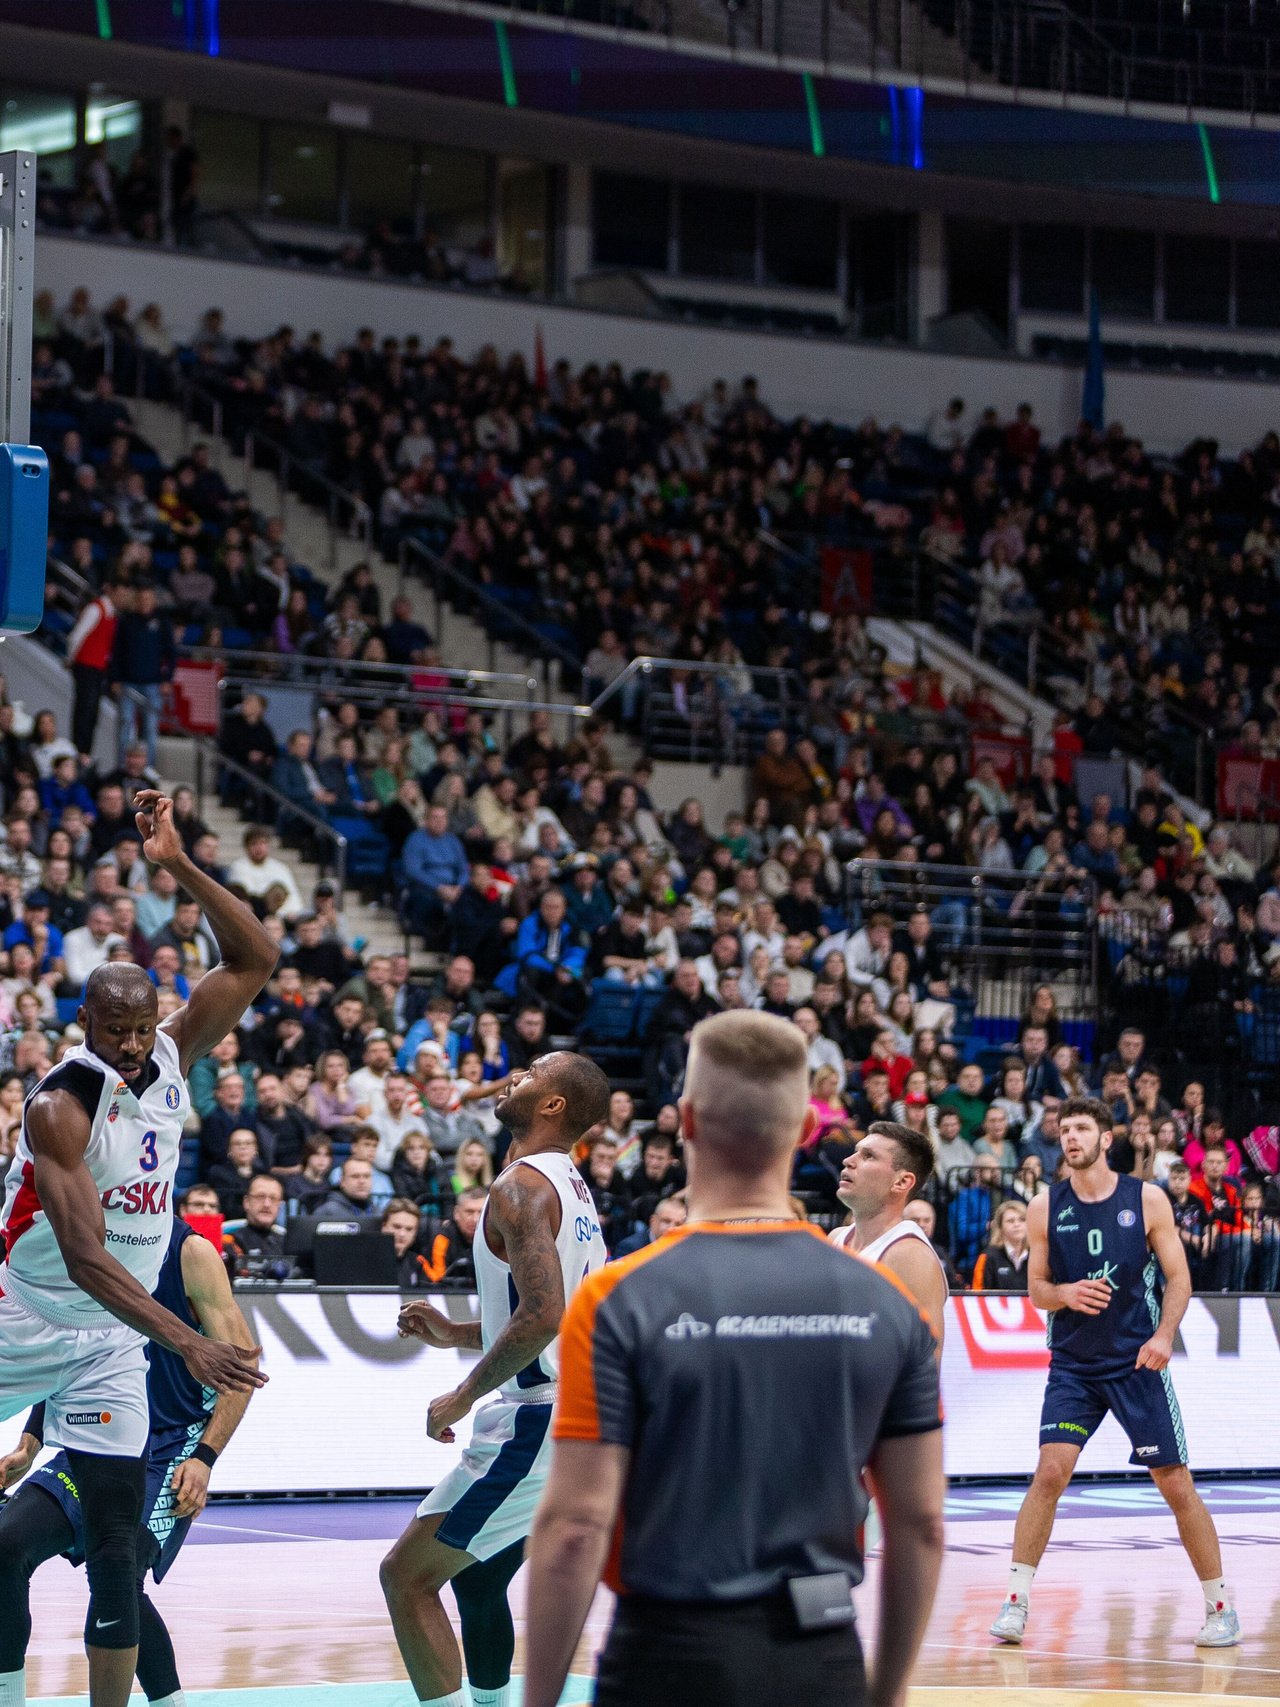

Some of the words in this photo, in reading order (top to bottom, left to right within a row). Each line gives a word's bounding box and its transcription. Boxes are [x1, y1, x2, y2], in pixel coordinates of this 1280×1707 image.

[139, 1130, 159, 1172] 3
[102, 1181, 169, 1215] CSKA
[1087, 1228, 1103, 1256] 0
[67, 1413, 99, 1424] Winline
